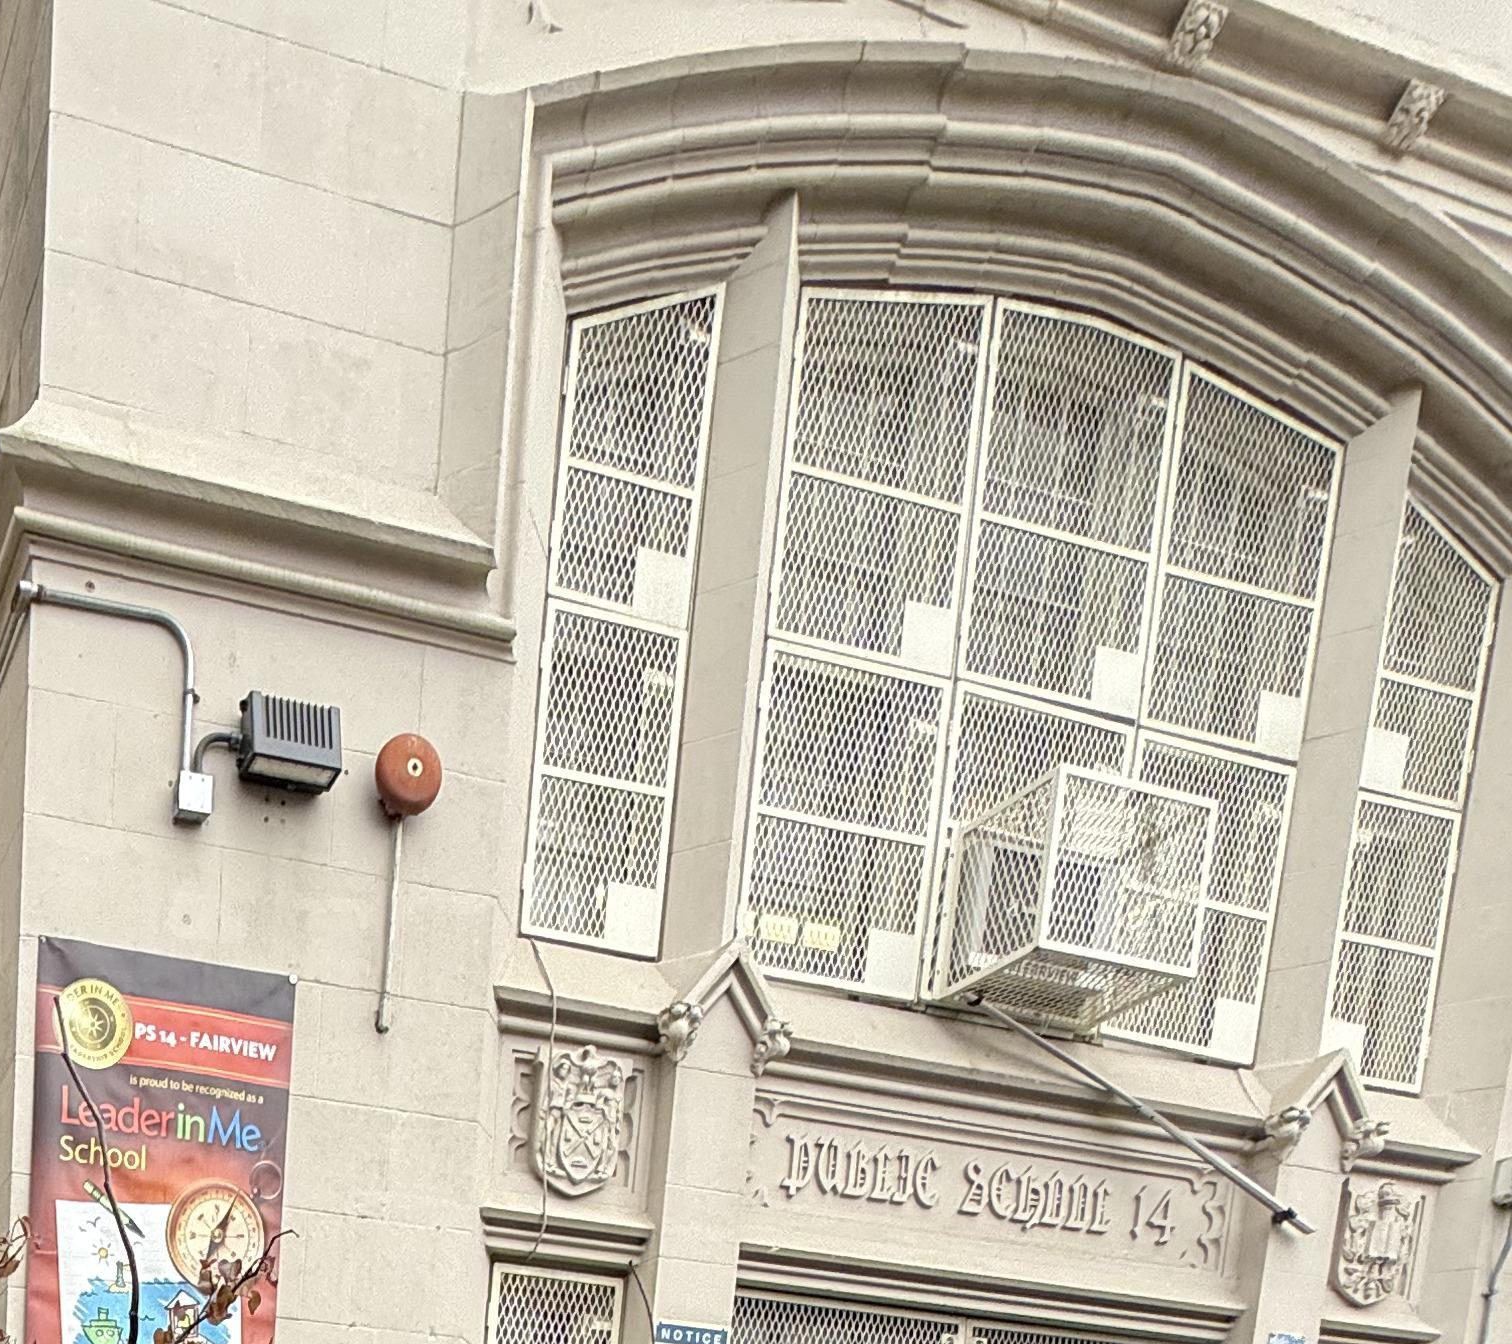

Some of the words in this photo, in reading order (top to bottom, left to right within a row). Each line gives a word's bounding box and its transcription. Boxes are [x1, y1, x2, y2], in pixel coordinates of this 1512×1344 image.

[134, 1022, 157, 1042] PS
[158, 1027, 178, 1048] 14
[189, 1031, 278, 1063] FAIRVIEW
[129, 1074, 138, 1086] is
[139, 1076, 169, 1090] proud
[170, 1079, 180, 1091] to
[181, 1080, 195, 1093] be
[195, 1084, 246, 1103] recognized
[246, 1093, 257, 1103] as
[258, 1095, 264, 1105] a
[58, 1134, 147, 1172] School
[780, 1131, 942, 1209] PUBLIC
[1128, 1184, 1177, 1246] 14
